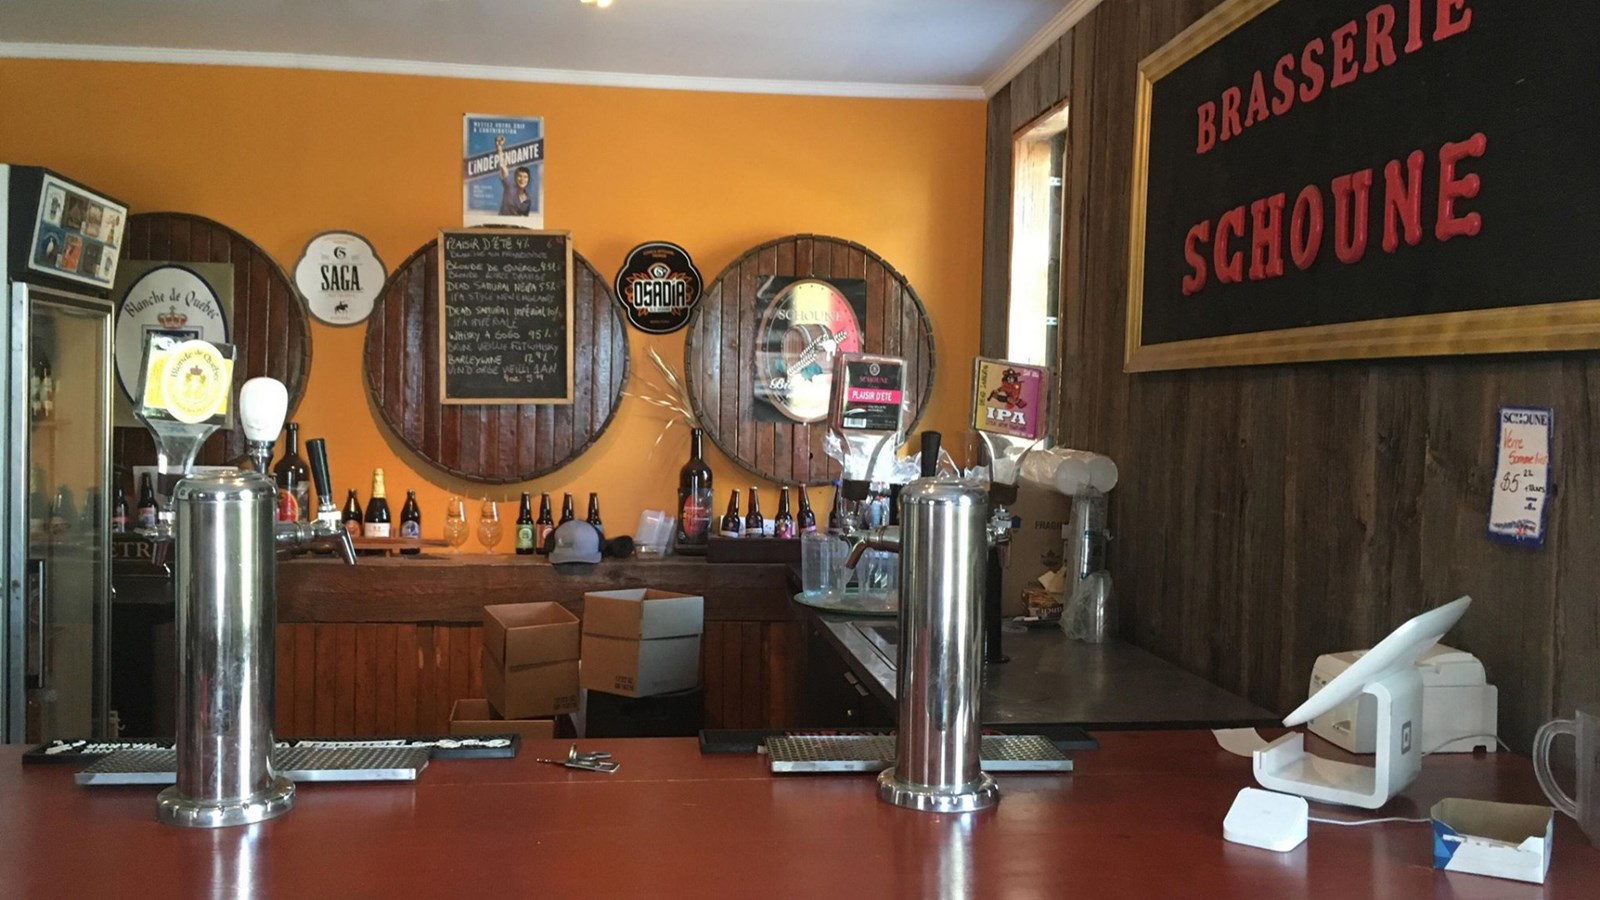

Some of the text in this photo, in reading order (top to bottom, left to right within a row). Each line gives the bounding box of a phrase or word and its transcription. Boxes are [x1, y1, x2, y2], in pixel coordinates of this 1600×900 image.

[1196, 0, 1473, 154] BRASSERIE
[1182, 131, 1487, 296] SCHOUNE
[446, 236, 480, 250] PLAISIR
[446, 260, 483, 271] BLONDE
[320, 264, 360, 291] SAGA
[446, 281, 470, 292] DEAD
[473, 281, 510, 293] SAMURAI
[124, 290, 165, 318] Blanche
[168, 288, 181, 302] de
[446, 306, 472, 318] DEAD
[475, 306, 510, 317] SAMURAI
[778, 309, 842, 322] SCHOUNE
[448, 330, 480, 342] WHISKY
[852, 390, 874, 401] PLAISIR
[986, 407, 1026, 425] IPA
[1504, 428, 1524, 449] Verre
